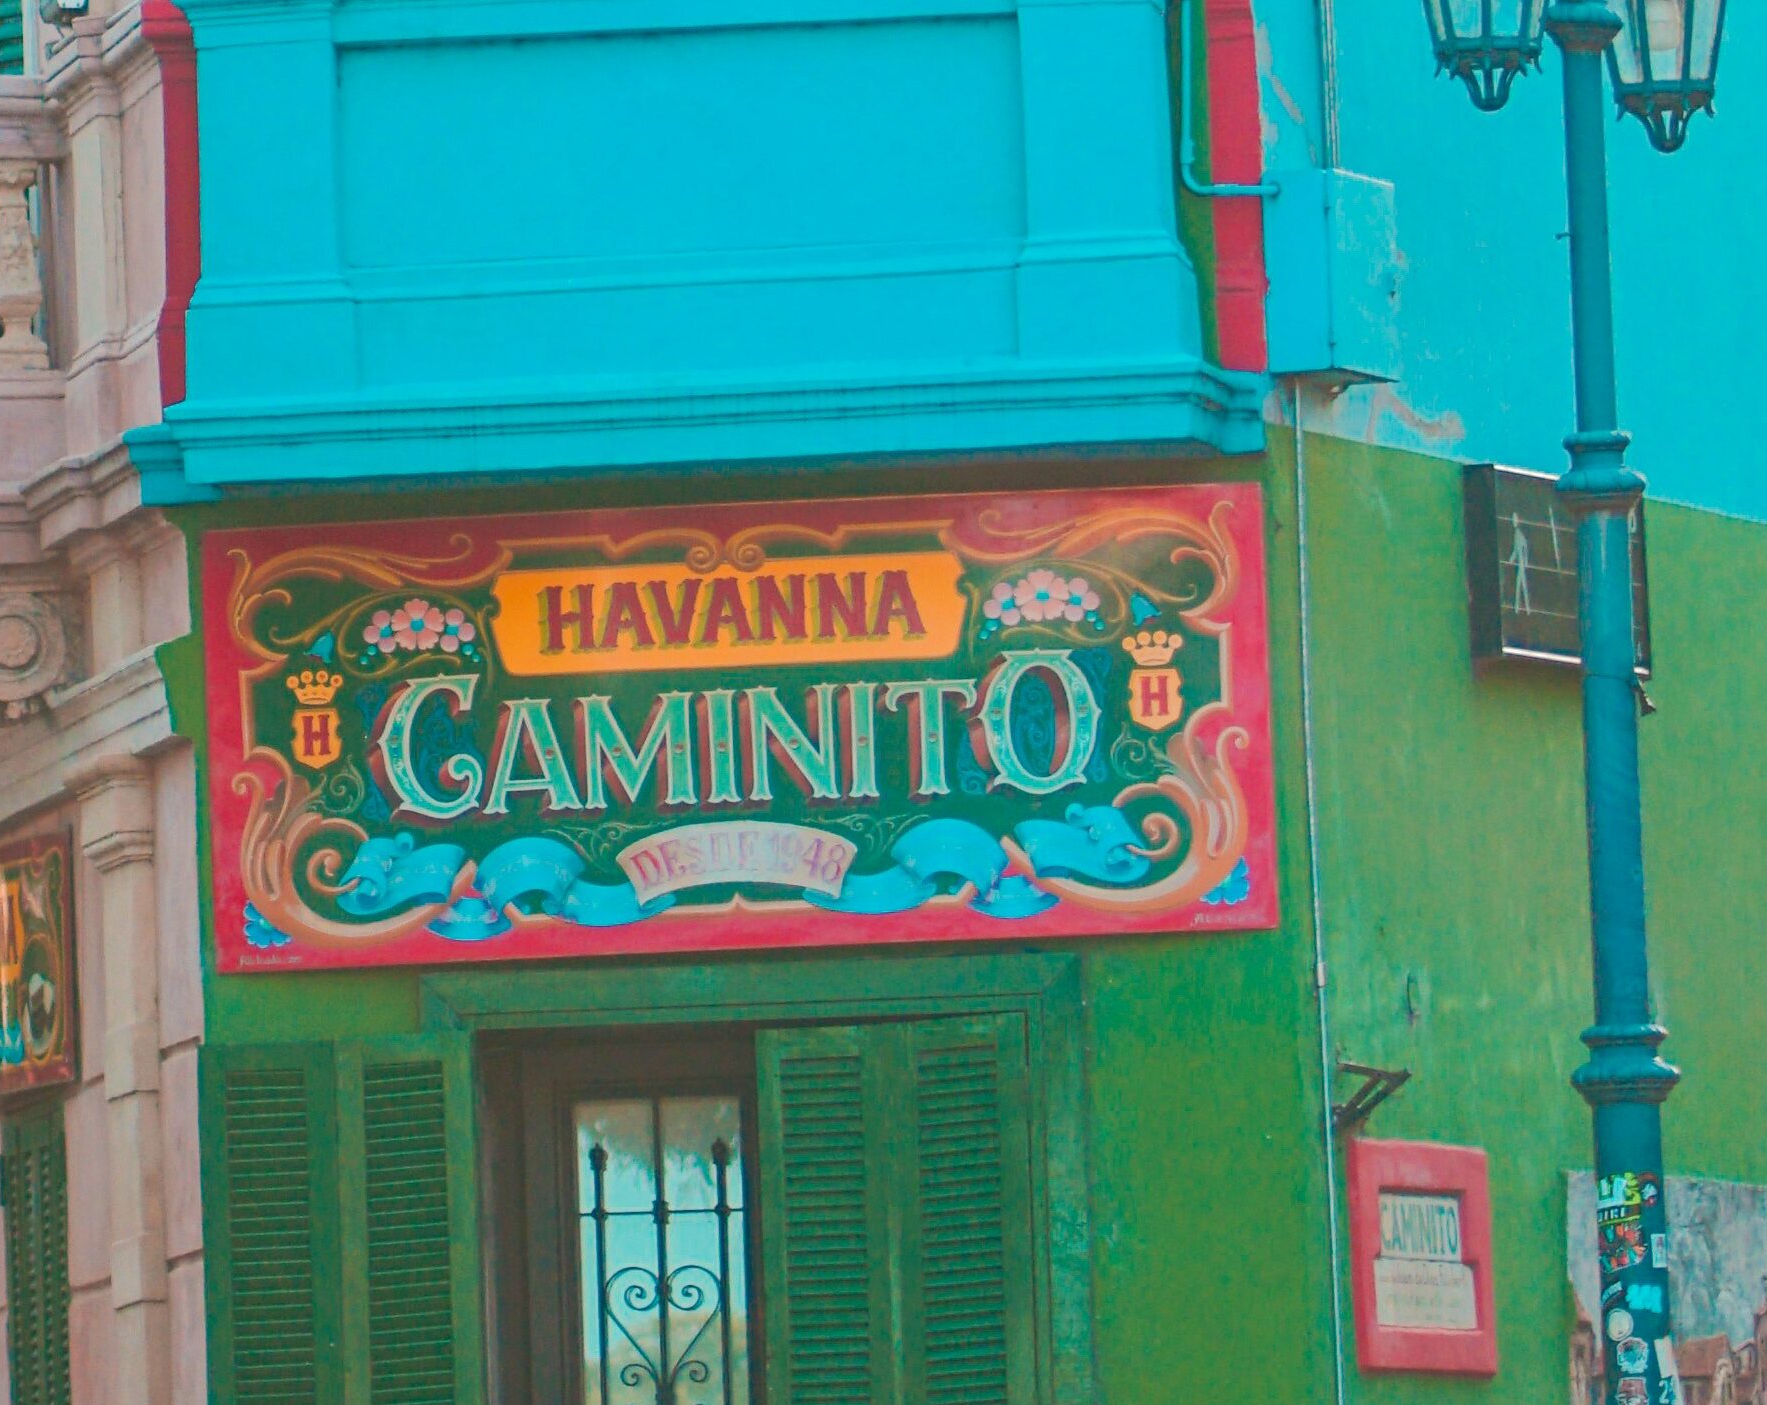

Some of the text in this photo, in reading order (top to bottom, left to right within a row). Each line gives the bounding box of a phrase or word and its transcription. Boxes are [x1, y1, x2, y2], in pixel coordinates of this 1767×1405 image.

[537, 570, 927, 654] HAVANNA
[1138, 674, 1171, 719] H
[301, 711, 331, 757] H
[376, 648, 1102, 818] CAMINITO
[630, 830, 846, 890] DESDE 1948
